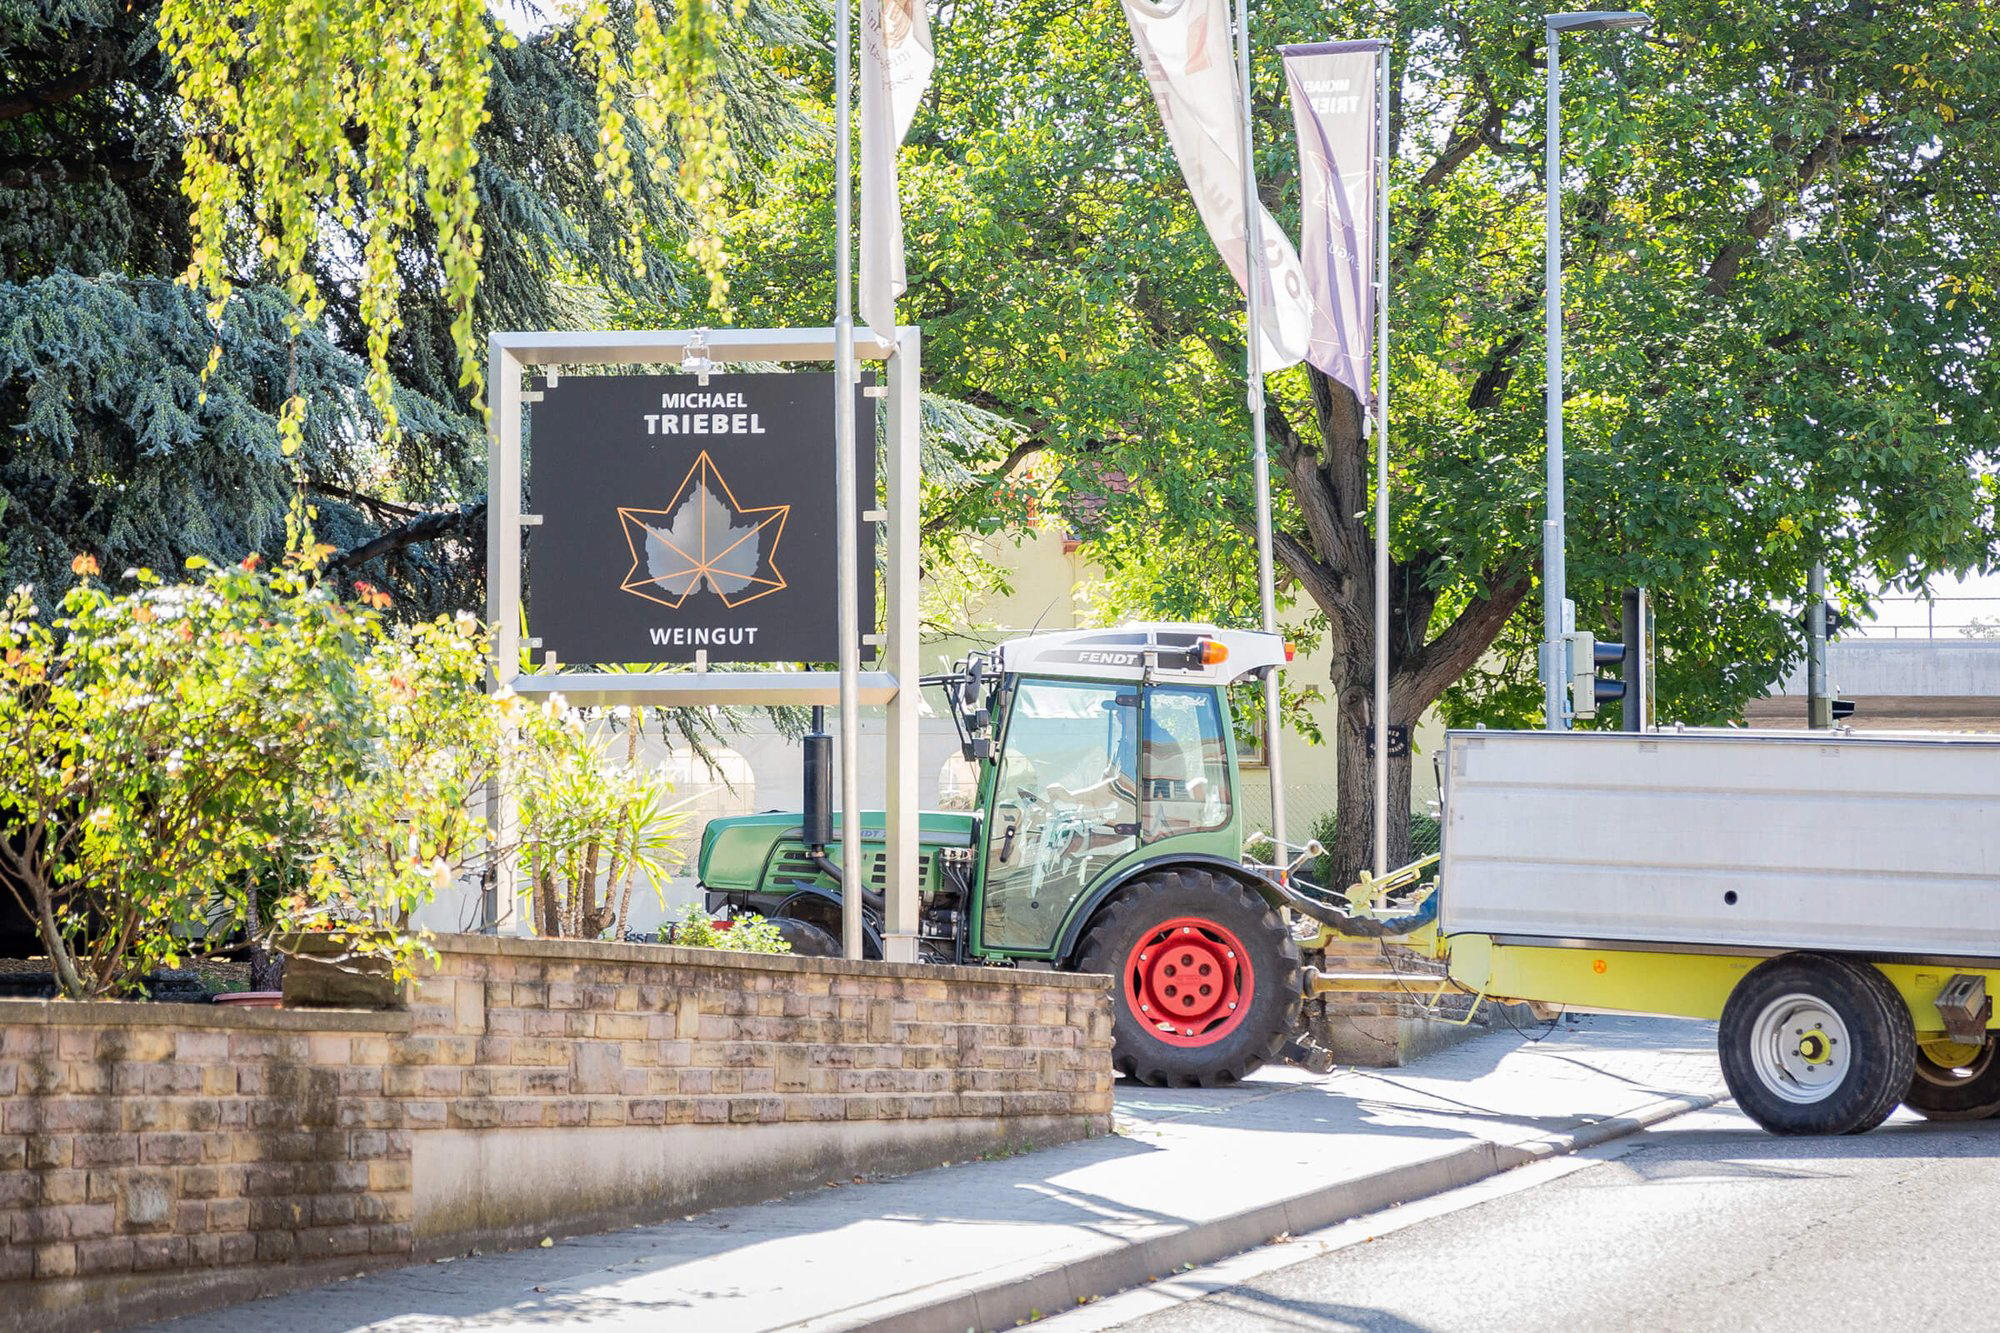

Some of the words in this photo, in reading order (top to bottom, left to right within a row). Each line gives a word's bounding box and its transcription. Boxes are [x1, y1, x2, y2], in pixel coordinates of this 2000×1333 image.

[662, 393, 748, 409] MICHAEL
[643, 413, 766, 435] TRIEBEL
[649, 627, 758, 646] WEINGUT
[1078, 651, 1138, 665] FENDT
